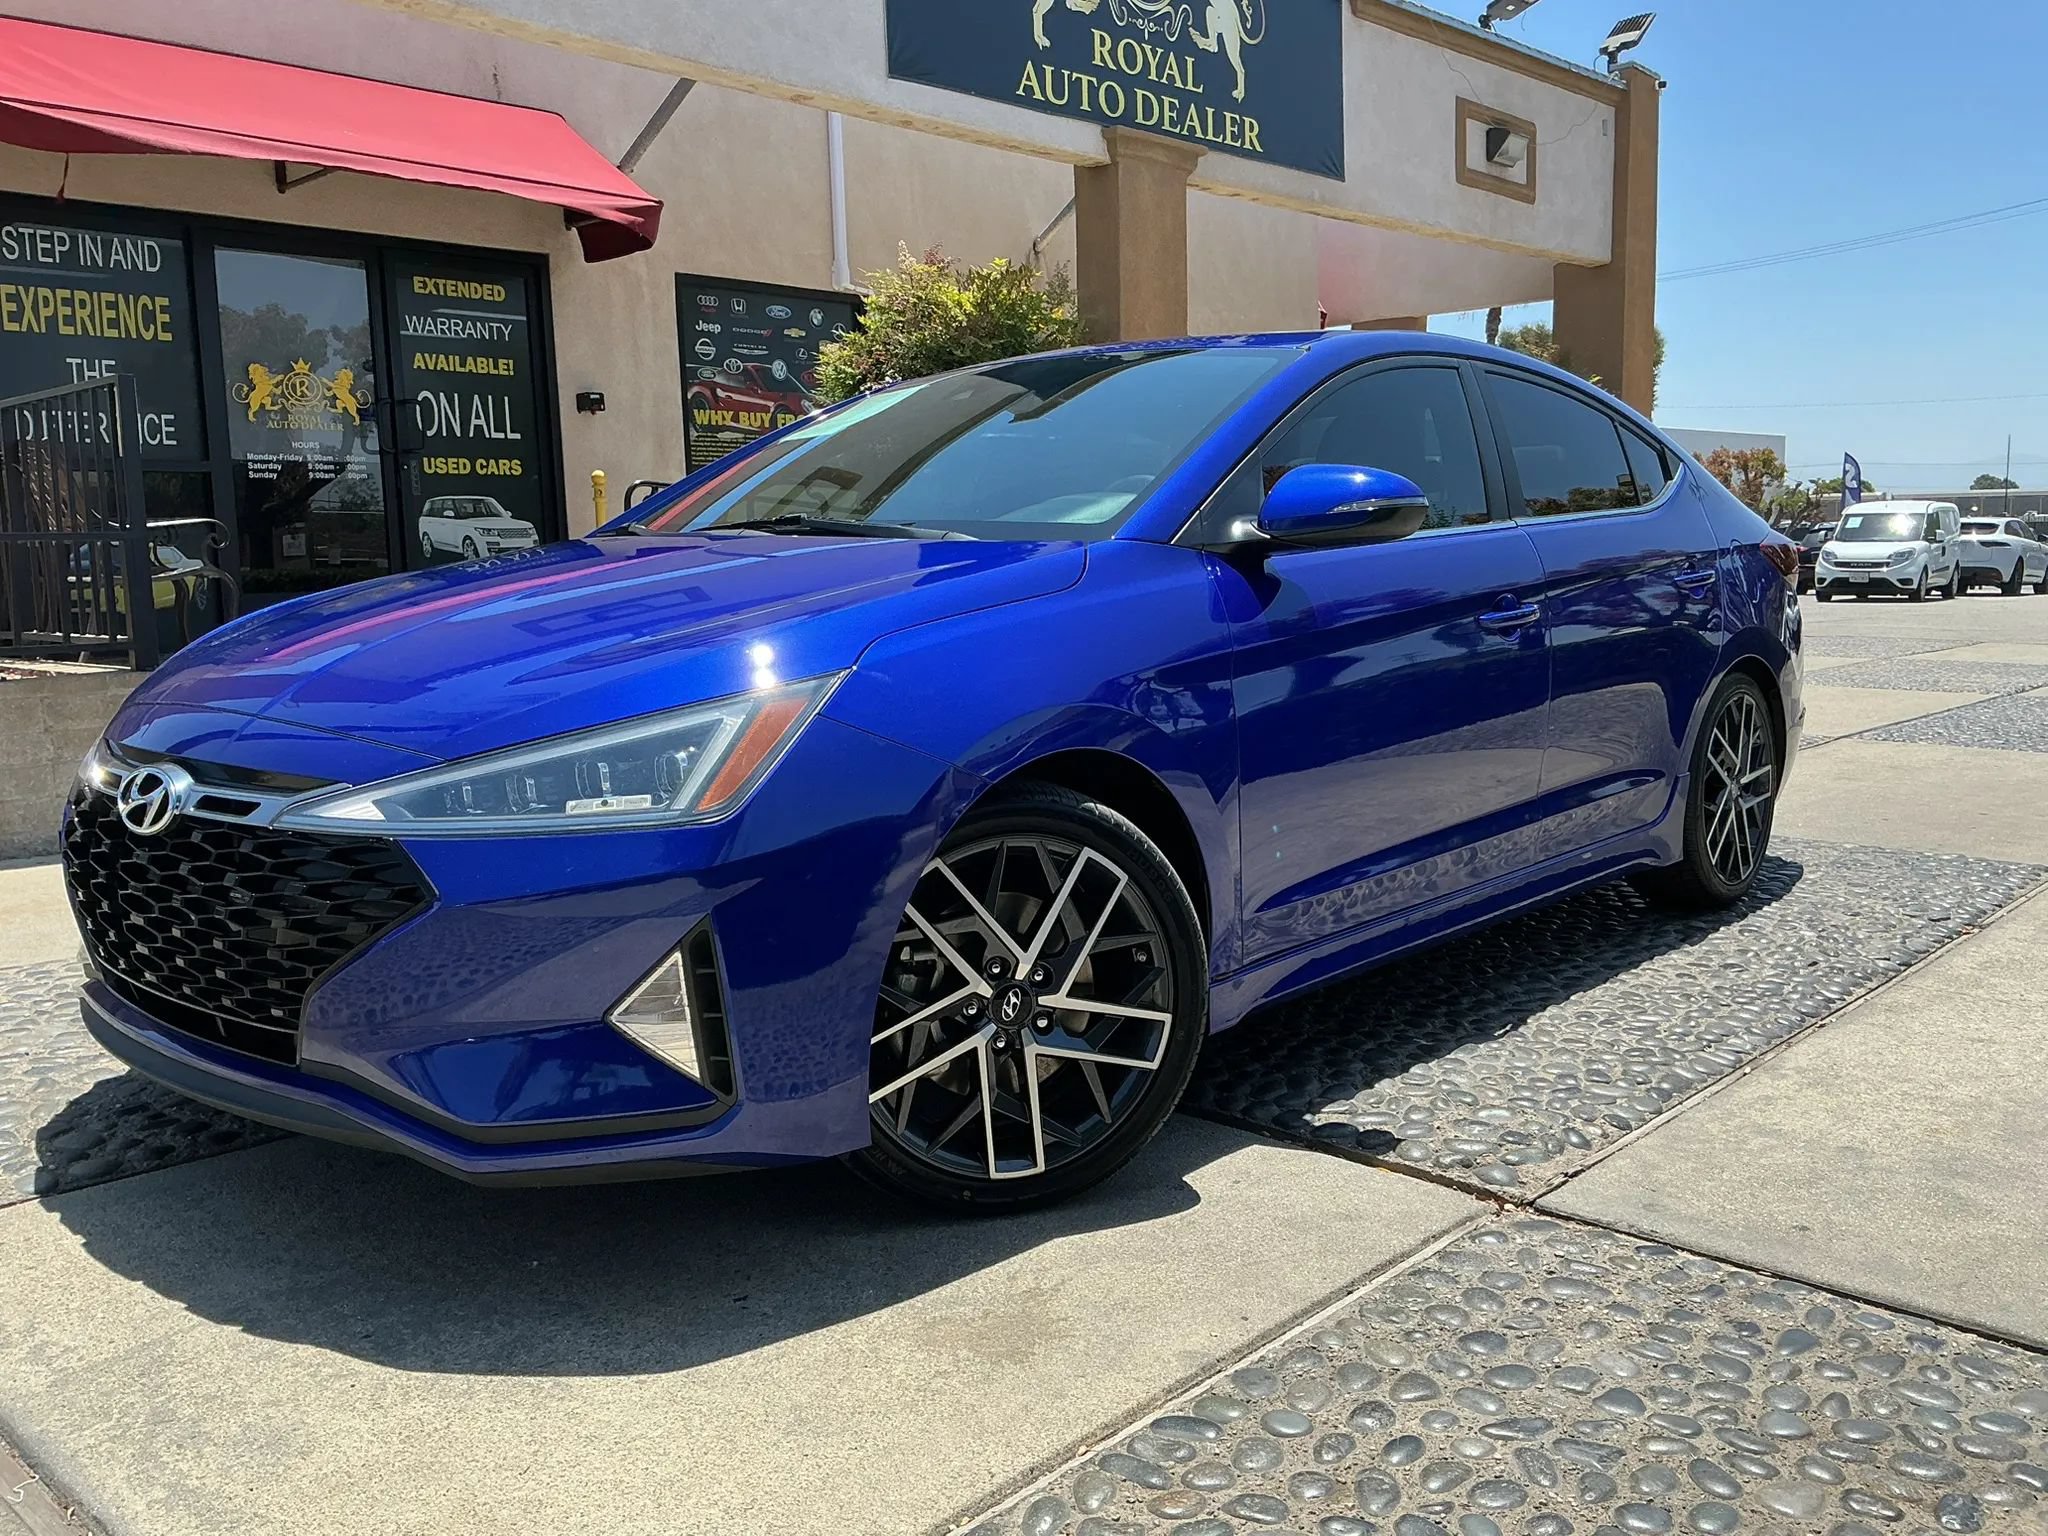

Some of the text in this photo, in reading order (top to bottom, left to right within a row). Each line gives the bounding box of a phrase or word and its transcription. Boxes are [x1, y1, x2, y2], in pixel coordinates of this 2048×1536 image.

[1091, 28, 1204, 93] ROYAL
[1015, 60, 1264, 152] AUTO DEALER
[1, 225, 161, 273] STEP IN AND
[412, 276, 506, 302] EXTENDED
[0, 283, 173, 341] EXPERIENCE
[405, 314, 513, 342] WARRANTY
[695, 320, 721, 334] Jeep
[65, 357, 116, 385] THE
[413, 352, 514, 376] AVAILABLE!
[266, 420, 344, 431] AUTO DEALER
[288, 413, 320, 422] ROYAL
[415, 390, 521, 439] ON ALL
[693, 409, 734, 426] WHY
[739, 412, 772, 428] BUY
[291, 441, 320, 449] HOURS
[246, 453, 303, 463] Monday-Friday
[247, 461, 282, 472] Saturday
[422, 456, 523, 476] USED CARS
[248, 471, 278, 480] Sunday
